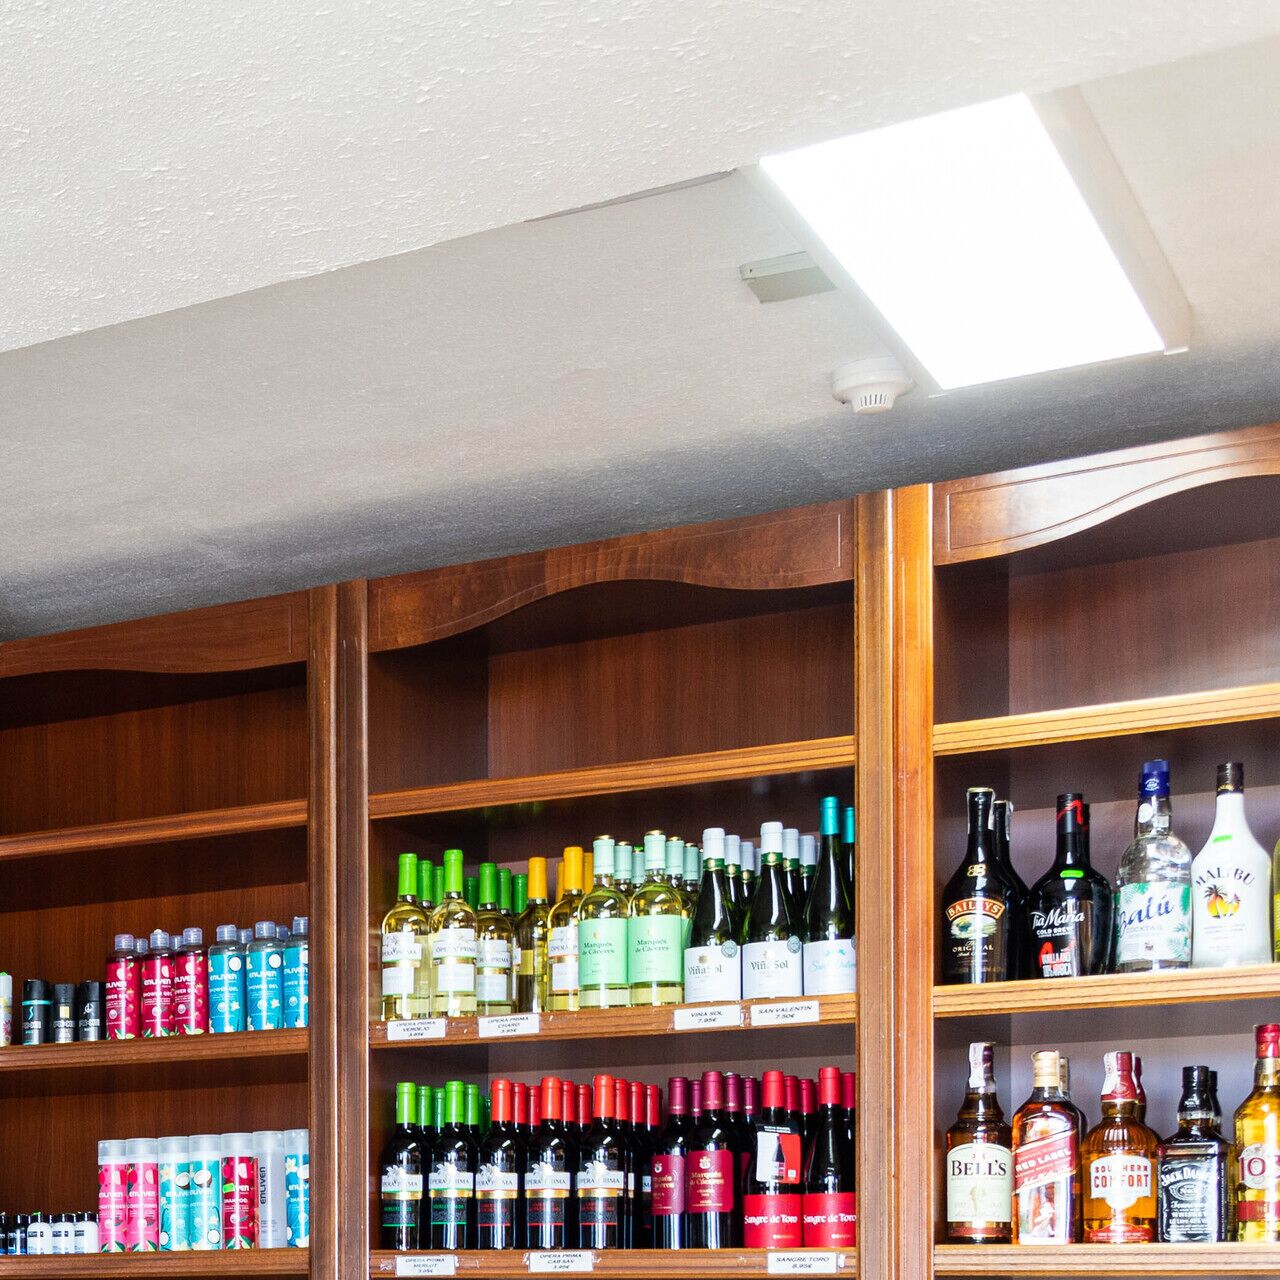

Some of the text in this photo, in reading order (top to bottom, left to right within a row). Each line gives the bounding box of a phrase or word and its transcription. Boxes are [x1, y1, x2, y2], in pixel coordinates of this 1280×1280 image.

[947, 901, 1001, 917] BAILEYS
[583, 942, 613, 950] Marqués
[776, 1005, 811, 1014] VALENTIN
[951, 1160, 1007, 1177] BELL'S
[781, 1213, 798, 1224] Toro
